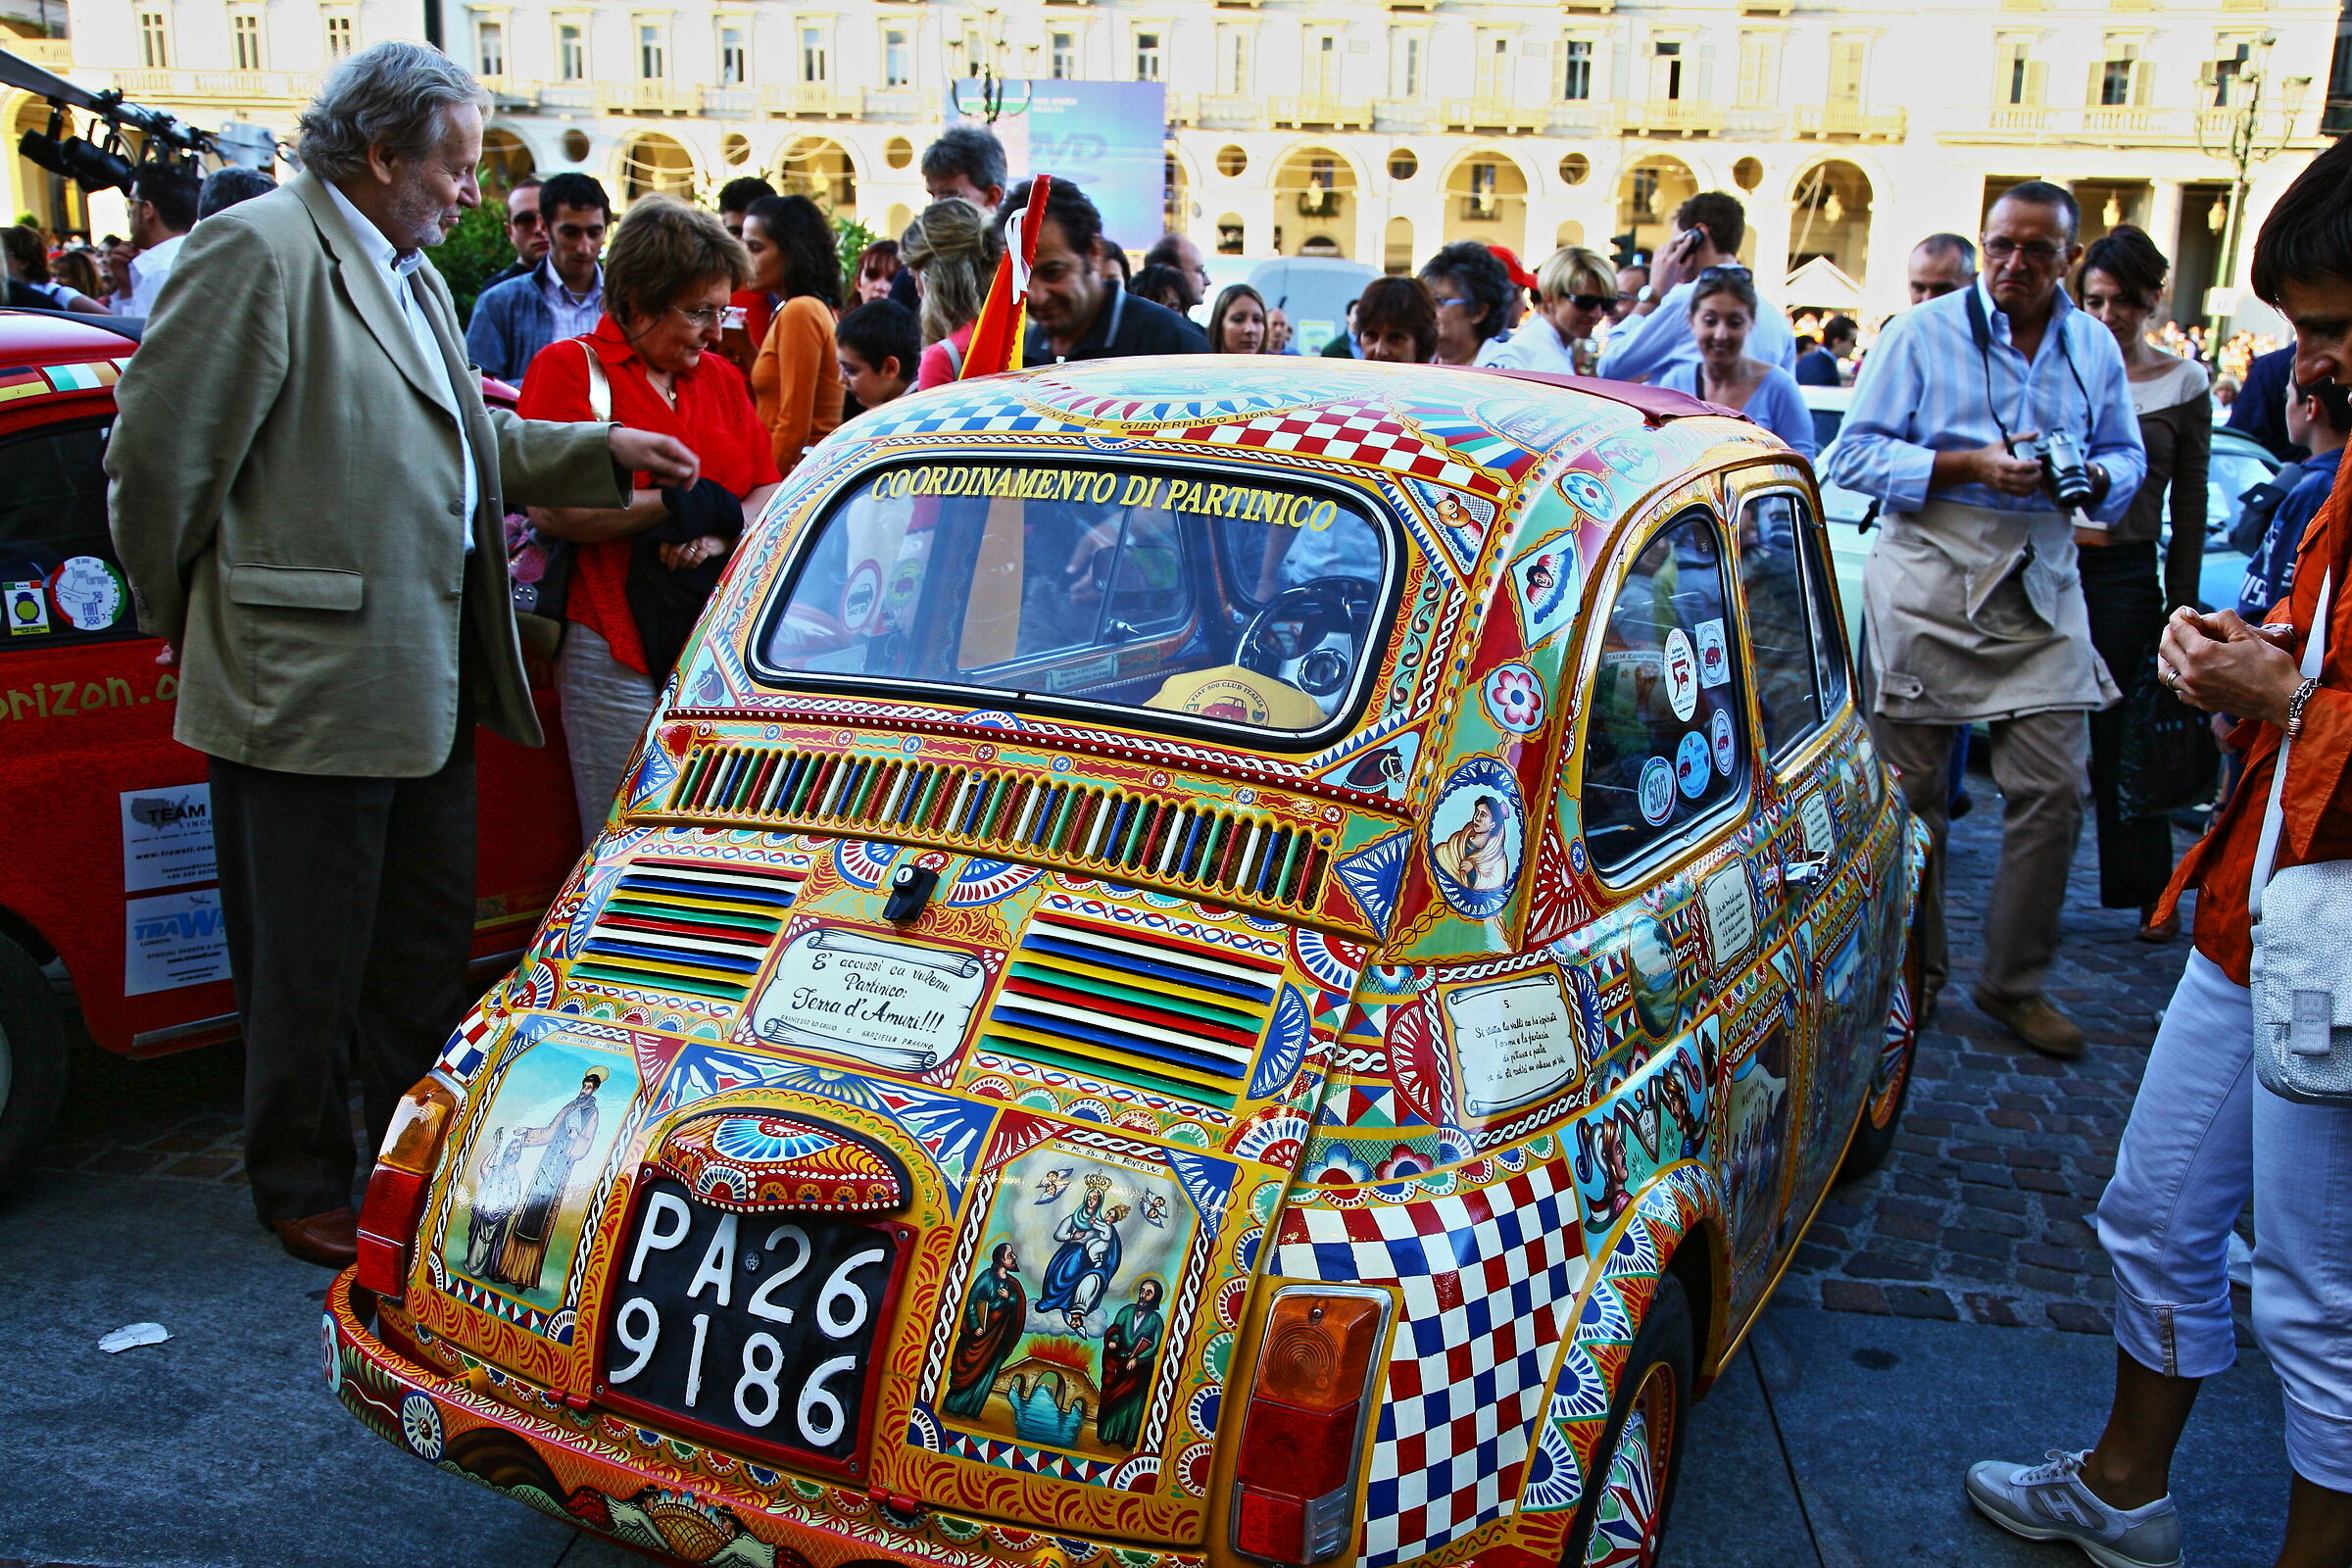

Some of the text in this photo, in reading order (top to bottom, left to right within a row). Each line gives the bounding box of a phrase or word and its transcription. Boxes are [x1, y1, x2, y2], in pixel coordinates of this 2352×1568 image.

[1120, 416, 1227, 430] GIANFRANCO
[1235, 410, 1276, 422] FIORE
[871, 466, 1338, 532] COORDINAMENTO DI PARTINICO
[81, 602, 99, 616] FIAT
[1191, 688, 1206, 703] FIAT
[1221, 681, 1244, 691] CLUB
[1243, 687, 1264, 709] ITALIA
[147, 804, 206, 823] TEAM
[889, 965, 906, 977] ca
[844, 972, 908, 1000] Partinico:
[791, 987, 842, 1013] Terra
[780, 1013, 811, 1027] FRANCESCO
[861, 1029, 898, 1044] GRAZIELLA
[1085, 1149, 1099, 1158] SS.
[1103, 1153, 1116, 1163] DEL
[1121, 1156, 1146, 1170] PONTE
[628, 1191, 885, 1339] PA26
[610, 1297, 857, 1447] 9186
